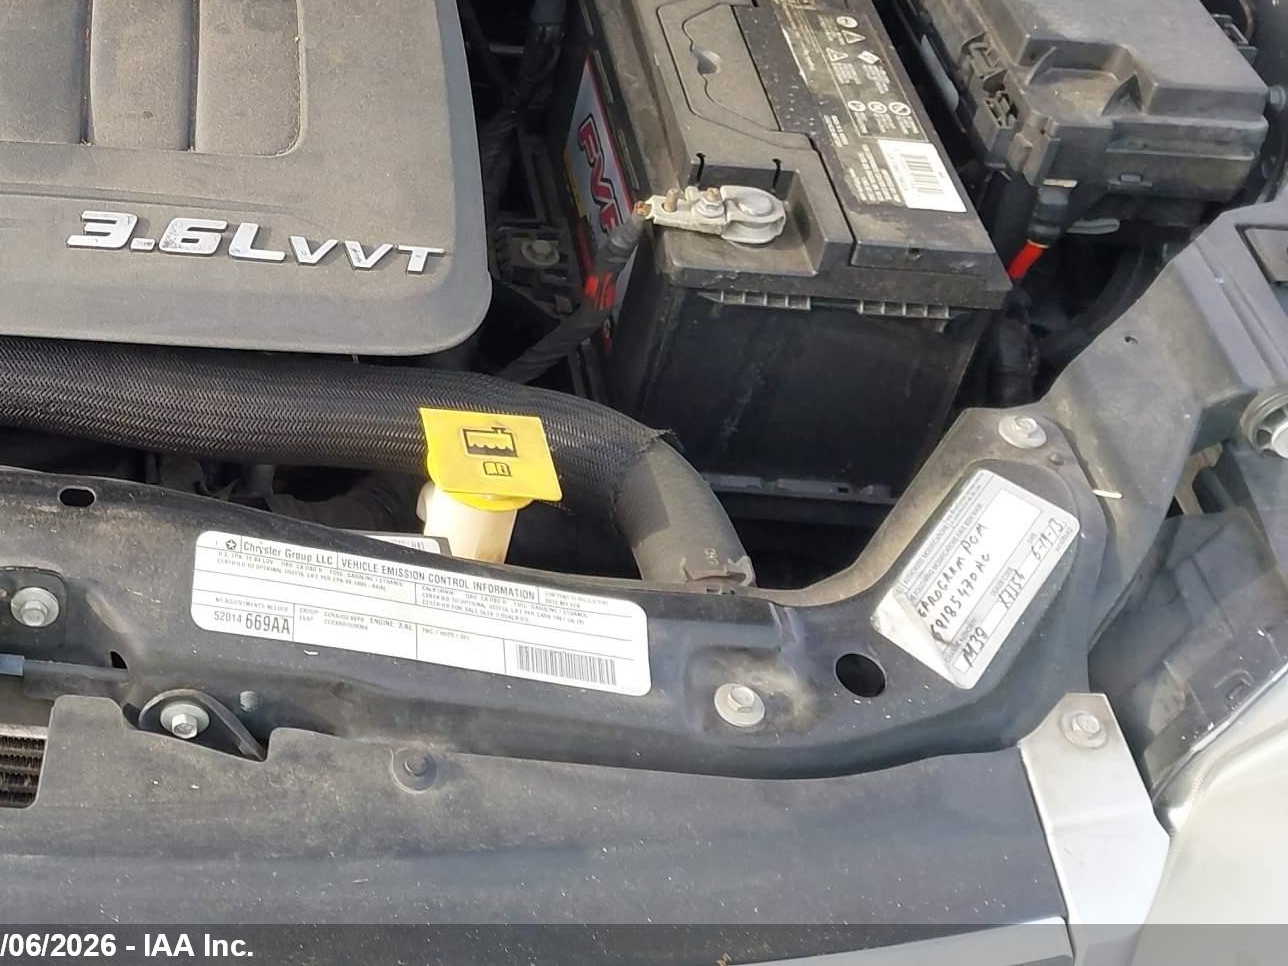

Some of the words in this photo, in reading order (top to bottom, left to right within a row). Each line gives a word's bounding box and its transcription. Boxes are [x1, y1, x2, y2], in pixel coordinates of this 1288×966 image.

[66, 210, 287, 263] 3.6L
[288, 235, 445, 275] VVT
[244, 541, 281, 557] Chrysler
[285, 548, 312, 564] Group
[316, 554, 333, 566] LLC
[341, 558, 378, 573] VEHICLE
[382, 565, 425, 581] EMISSION
[428, 573, 470, 590] CONTROL
[473, 581, 535, 600] INFORMATION
[214, 610, 242, 623] 52014
[245, 612, 290, 635] 669AA
